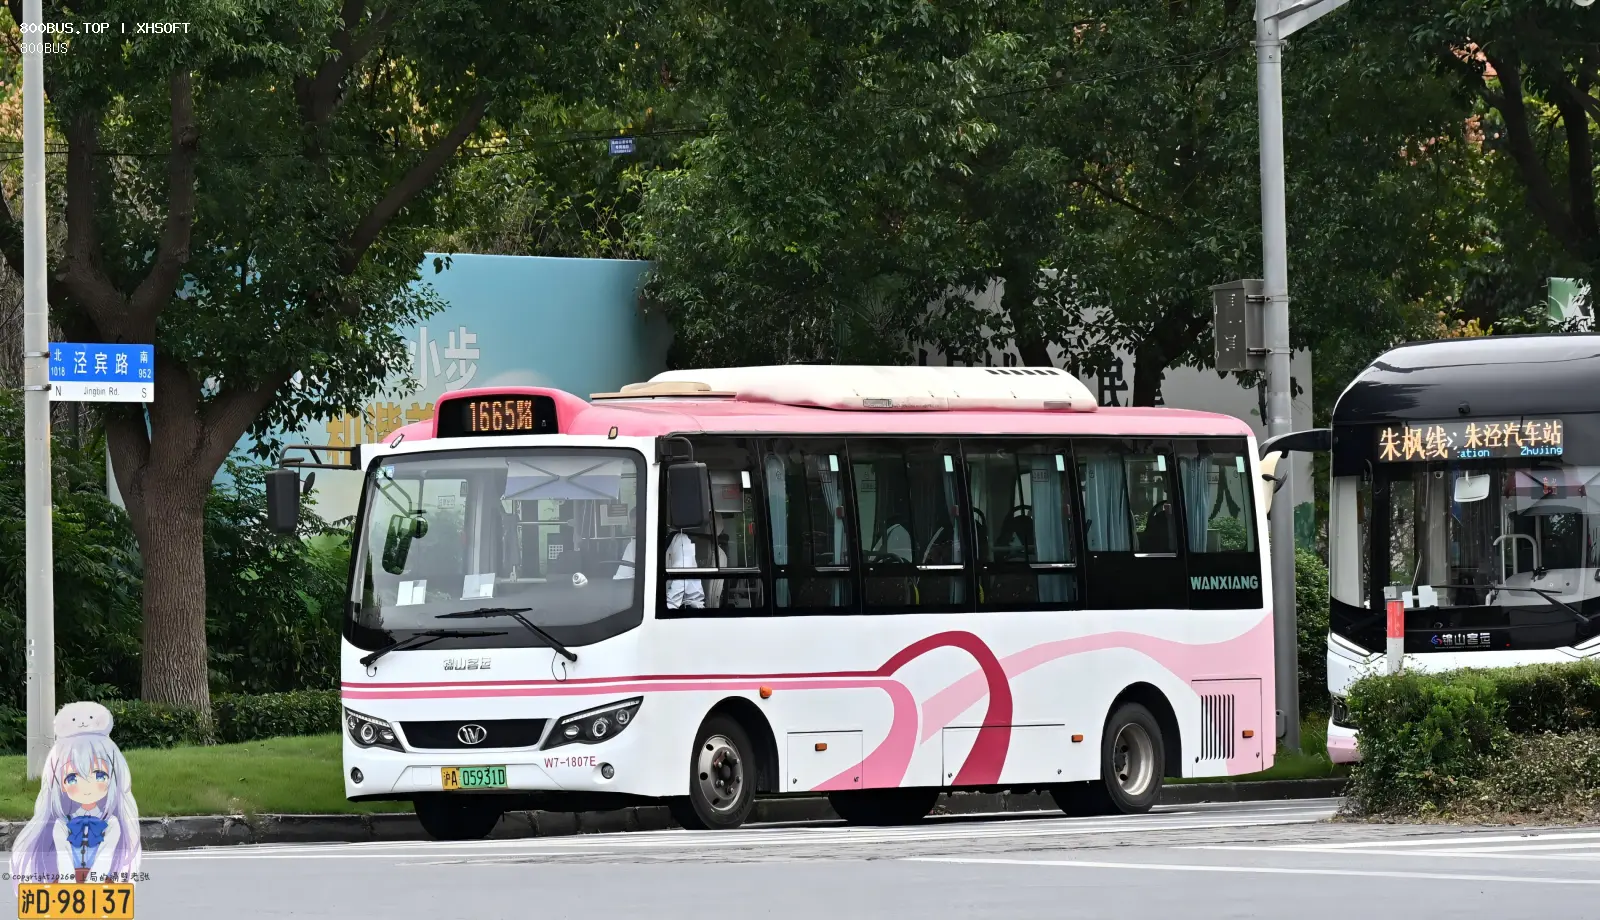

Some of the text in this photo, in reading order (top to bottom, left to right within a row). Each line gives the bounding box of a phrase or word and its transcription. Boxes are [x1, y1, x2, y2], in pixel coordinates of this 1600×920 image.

[54, 348, 62, 362] 北
[139, 350, 149, 364] 南
[74, 350, 128, 375] 泾宾路
[51, 366, 66, 377] 1018
[138, 368, 152, 379] 952
[55, 385, 62, 397] N
[83, 387, 120, 398] Jingbin Rd.
[141, 387, 148, 399] S
[469, 400, 533, 432] 1665路
[1379, 419, 1562, 461] 朱枫线 朱泾汽车站
[1520, 445, 1563, 457] Zhujing
[1190, 575, 1259, 590] WANXIANG
[544, 755, 596, 768] W7-1807E
[462, 768, 506, 787] 05931D
